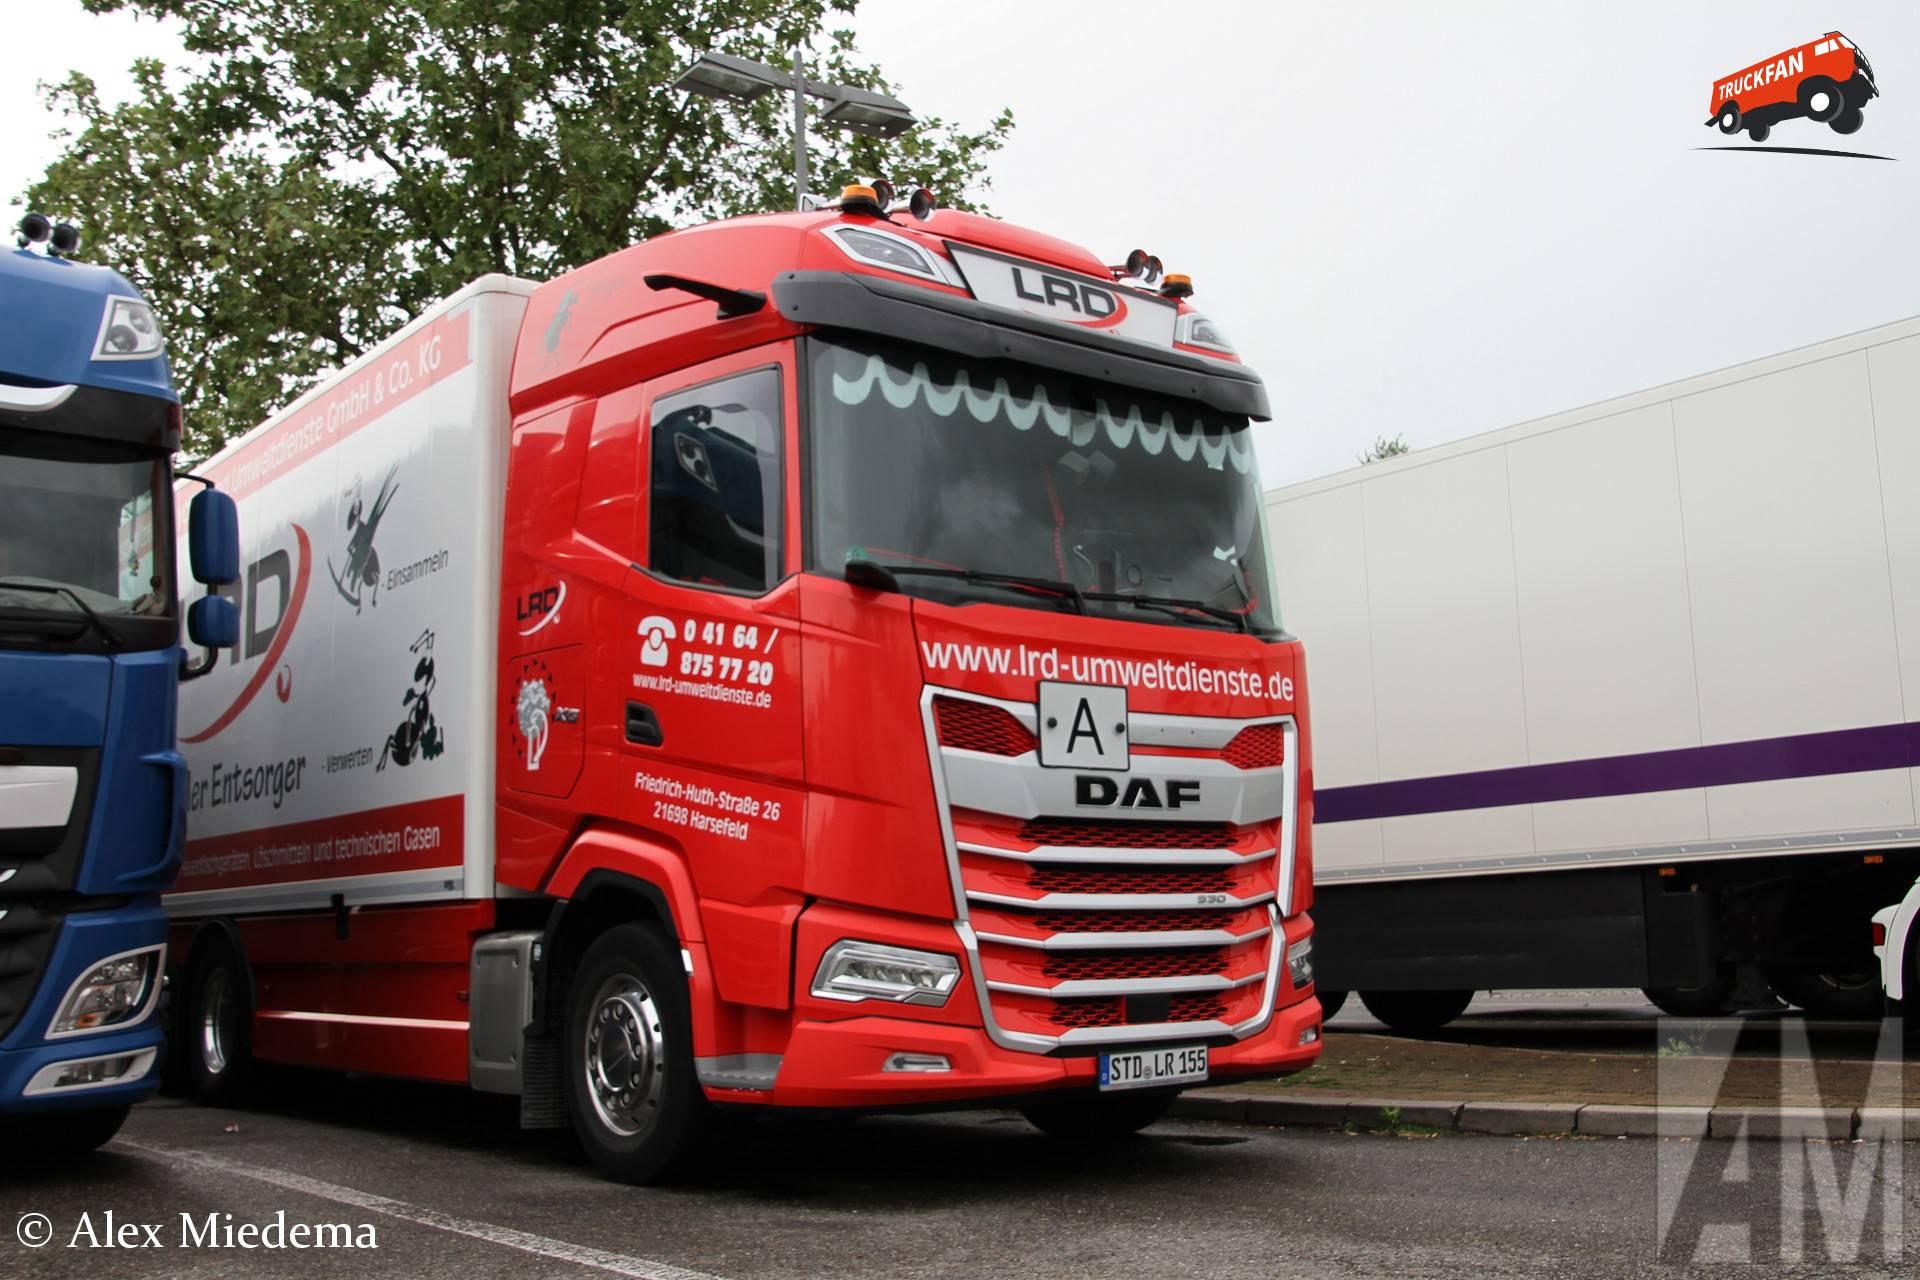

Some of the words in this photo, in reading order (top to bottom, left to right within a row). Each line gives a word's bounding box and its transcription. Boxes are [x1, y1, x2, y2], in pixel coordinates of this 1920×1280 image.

[1012, 266, 1117, 319] LRD
[327, 378, 370, 433] GmbH
[374, 371, 384, 405] &
[389, 360, 413, 395] Co.
[419, 334, 441, 377] KG
[387, 548, 448, 591] Einsammeln
[516, 586, 560, 622] LRD
[684, 619, 697, 643] 0
[702, 621, 725, 646] 41
[733, 624, 758, 650] 64
[763, 628, 779, 654] /
[680, 651, 714, 677] 875
[719, 656, 743, 681] 77
[747, 660, 774, 686] 20
[920, 640, 1295, 702] www.lrd-umweltdienste.de
[633, 673, 772, 708] www.lrd-umweltdienste.de
[1066, 697, 1104, 756] A
[211, 756, 306, 809] Entsorger
[634, 772, 760, 817] Friedrich-Huth-Straße
[762, 800, 781, 821] 26
[1075, 774, 1201, 809] DAF
[653, 801, 688, 825] 21698
[690, 810, 749, 841] Harsefeld
[313, 837, 333, 861] und
[335, 830, 400, 860] technischen
[404, 825, 441, 851] Gasen
[1111, 1055, 1142, 1080] STD
[1155, 1052, 1174, 1077] LR
[1179, 1049, 1206, 1074] 155
